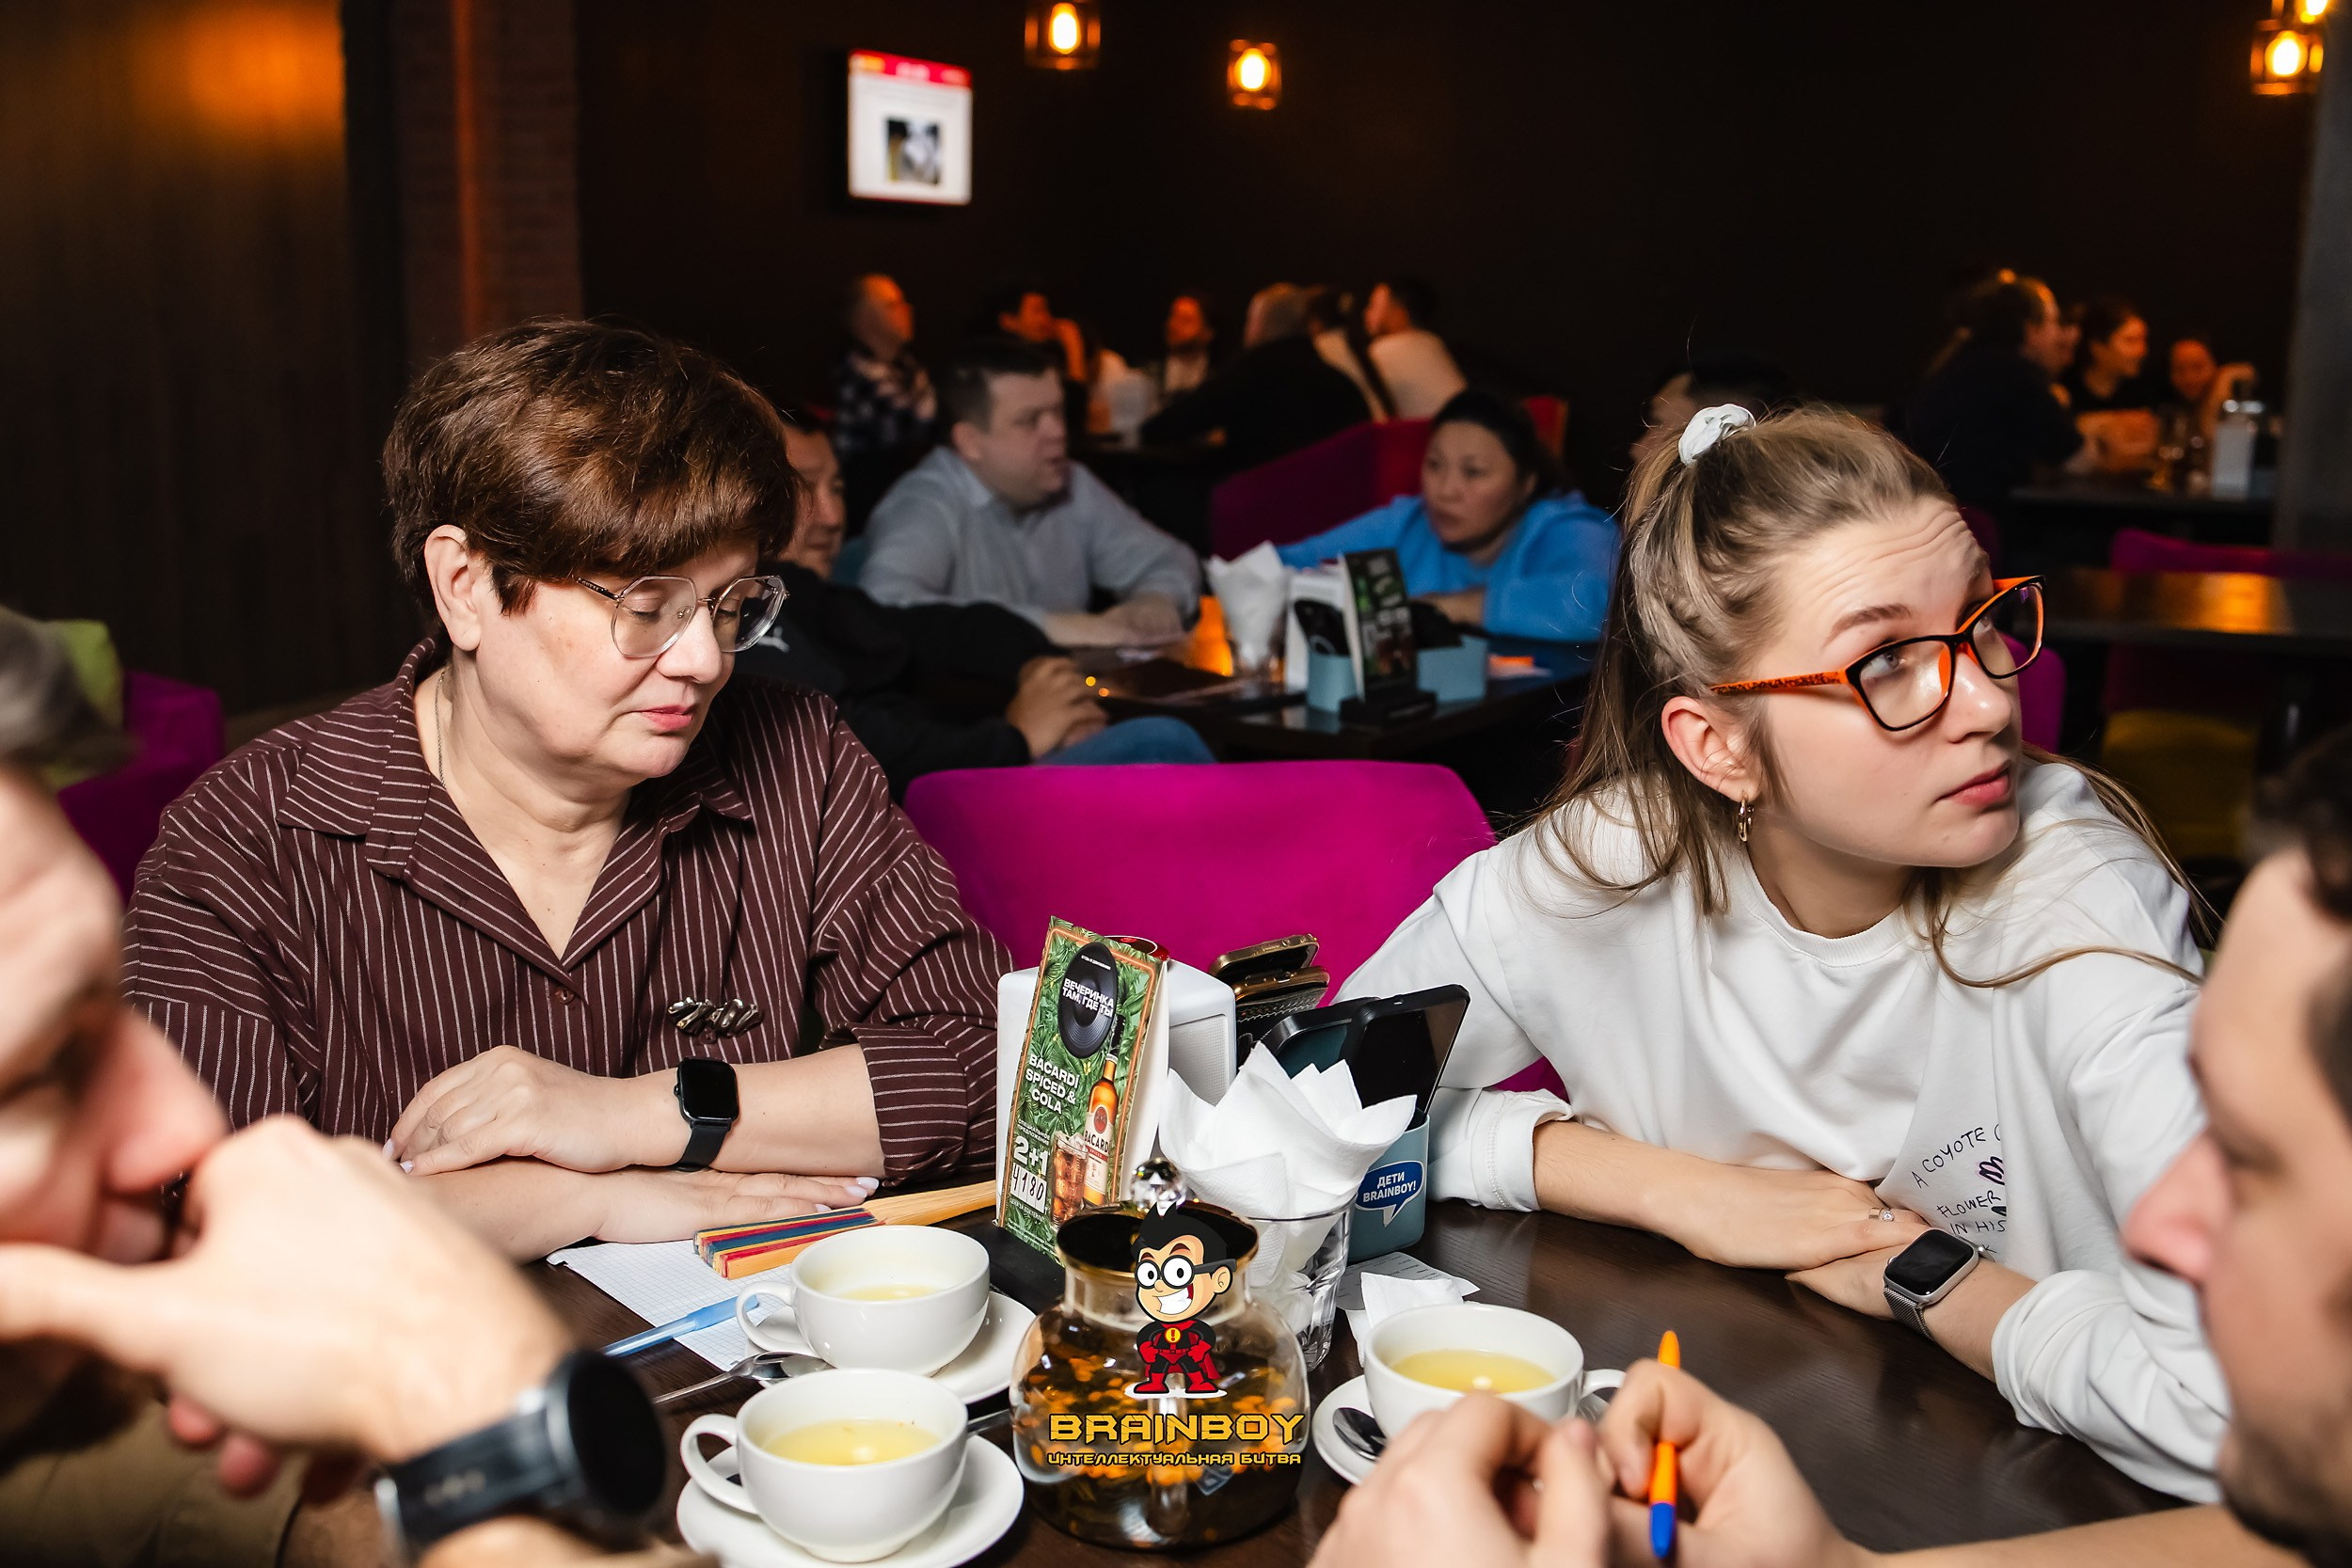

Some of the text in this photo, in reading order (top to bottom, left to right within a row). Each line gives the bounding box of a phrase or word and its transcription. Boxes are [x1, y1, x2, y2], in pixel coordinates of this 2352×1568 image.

[1062, 987, 1114, 1018] ТАМ, ГДЕ ТЫ
[1064, 978, 1114, 1007] ВЕЧЕРИНКА
[1025, 1068, 1076, 1104] SPICED &
[1032, 1088, 1062, 1114] COLA
[1014, 1135, 1049, 1176] 2+1
[1912, 1171, 1929, 1189] A
[1922, 1127, 1986, 1173] COYOTE
[1012, 1164, 1045, 1201] 4180
[1362, 1180, 1417, 1203] BRAINBOY!
[1376, 1171, 1405, 1189] ДЕТИ
[1936, 1190, 2001, 1218] FLOWER
[1950, 1219, 2007, 1235] IN HIS
